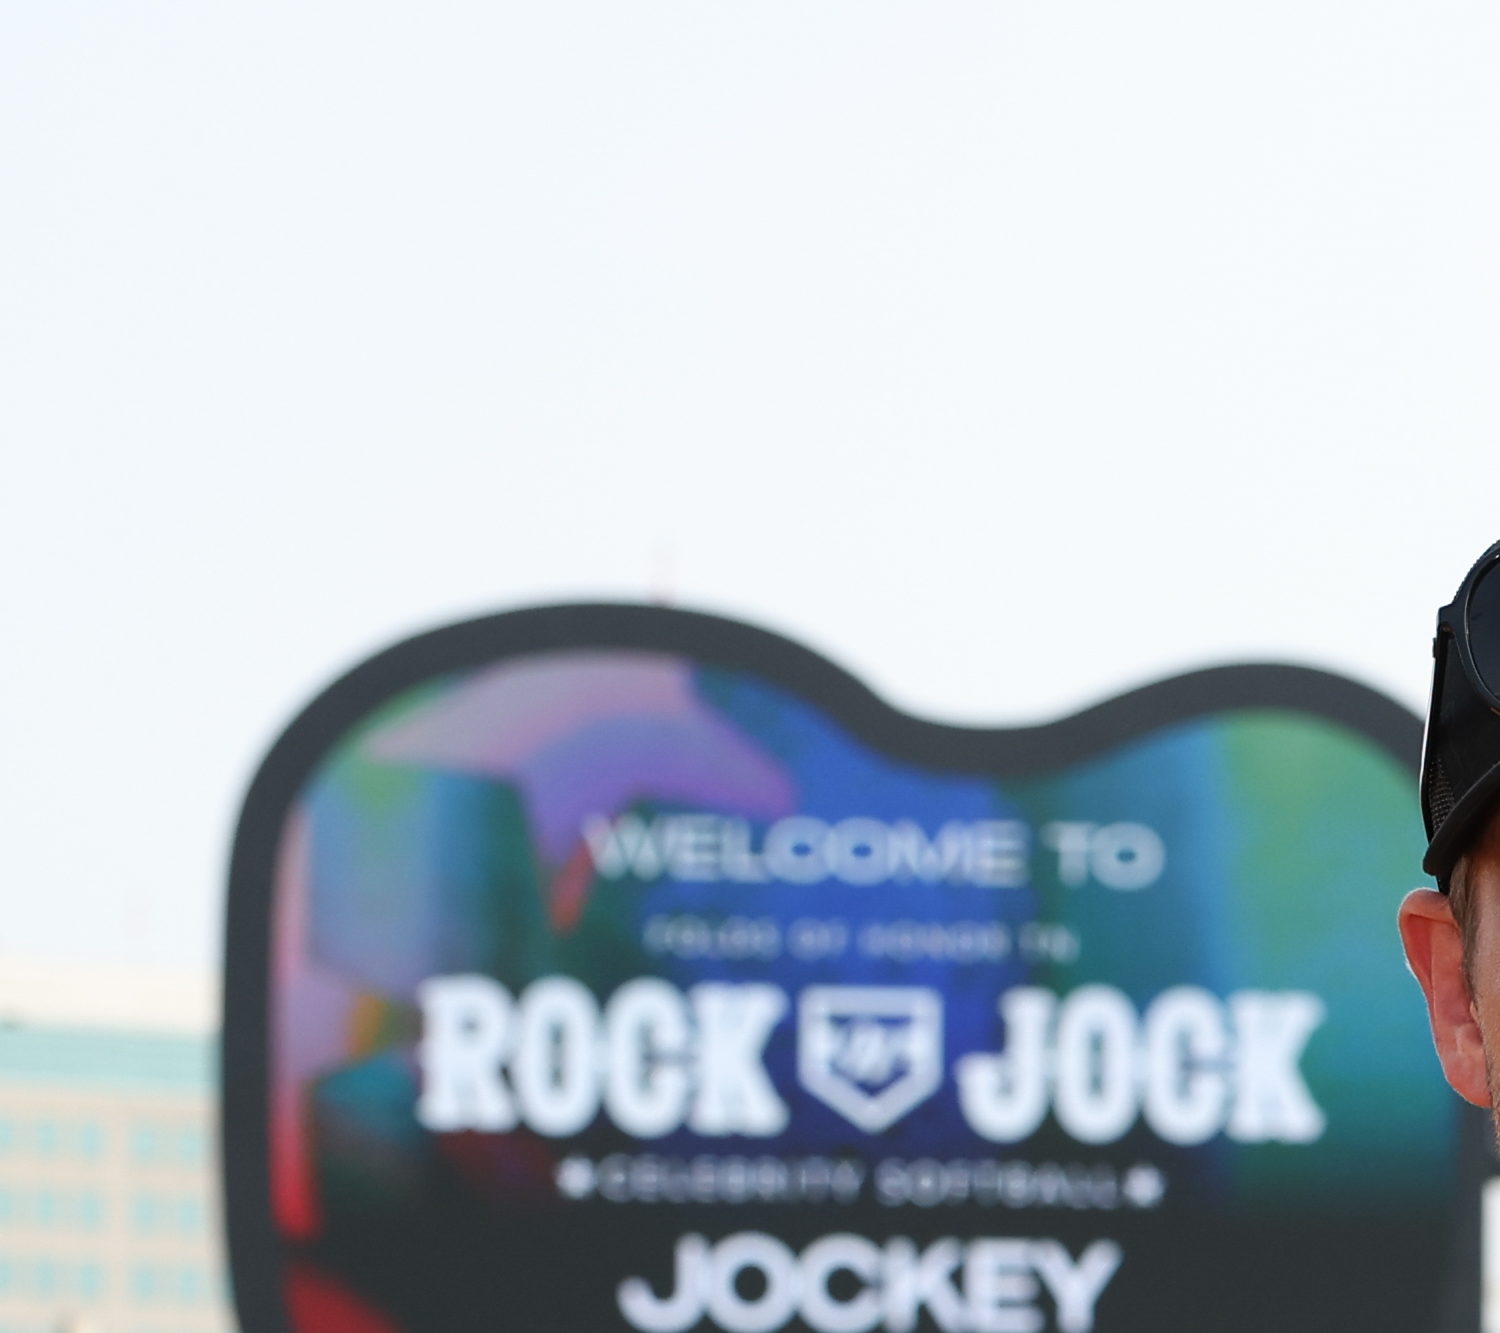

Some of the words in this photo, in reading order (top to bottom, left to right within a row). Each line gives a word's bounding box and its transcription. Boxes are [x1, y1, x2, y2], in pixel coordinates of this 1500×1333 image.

[585, 815, 1026, 884] WELCOME
[1047, 821, 1163, 888] TO
[418, 977, 789, 1138] ROCK
[956, 985, 1327, 1143] JOCK
